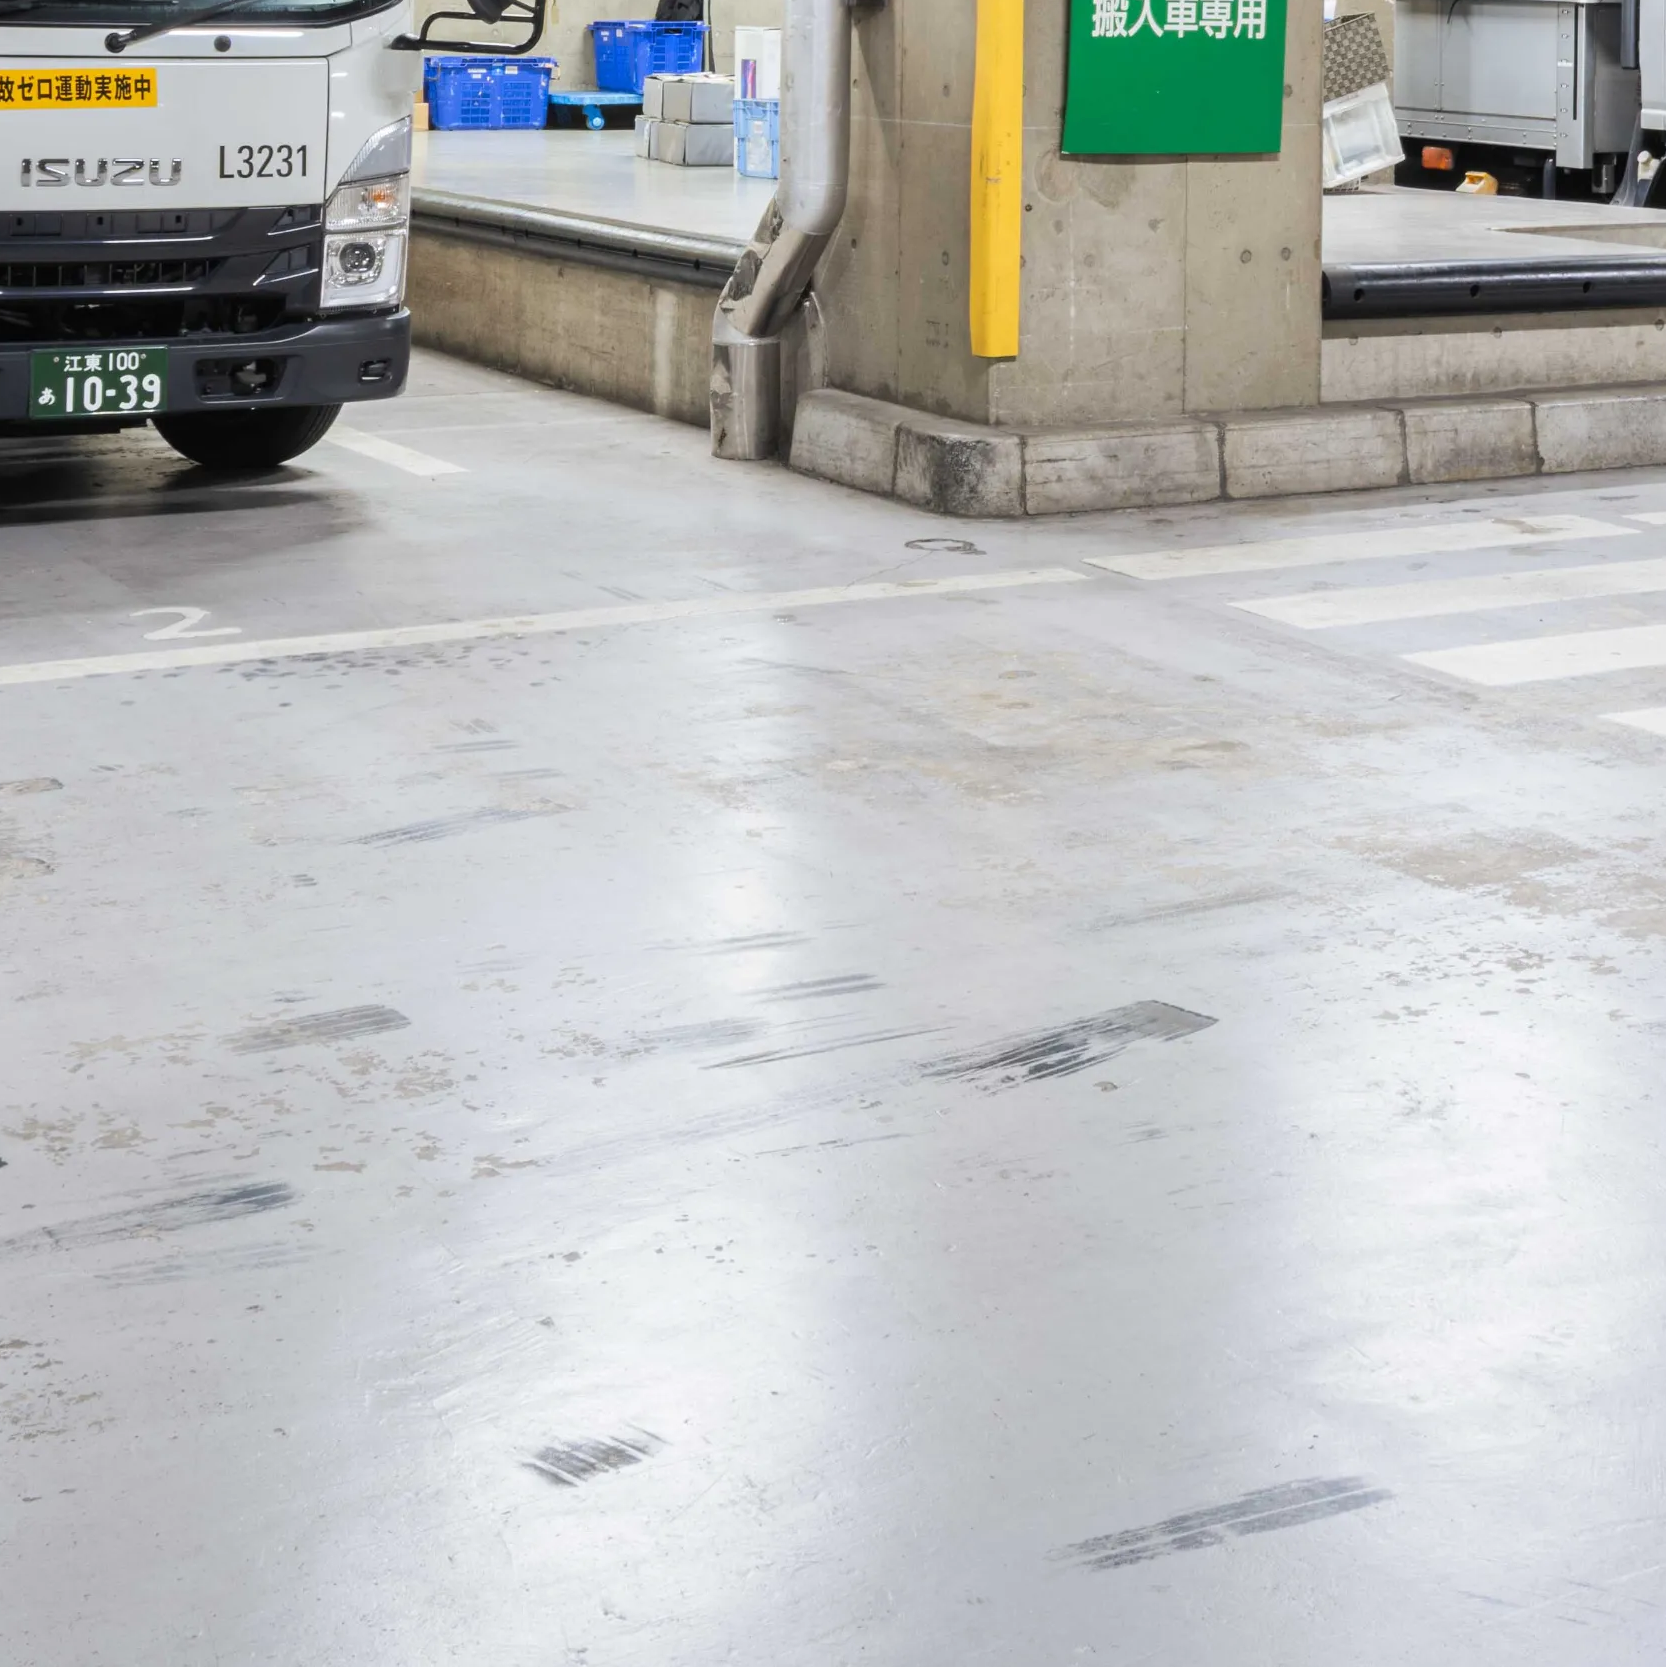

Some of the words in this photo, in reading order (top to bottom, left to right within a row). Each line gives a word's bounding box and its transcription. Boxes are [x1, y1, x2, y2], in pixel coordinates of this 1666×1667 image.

[20, 157, 182, 187] ISUZU
[219, 144, 308, 179] L3231
[63, 353, 103, 372] 江東
[108, 351, 140, 372] 100
[38, 387, 56, 406] あ
[65, 373, 162, 413] 10-39
[129, 606, 243, 641] 2
